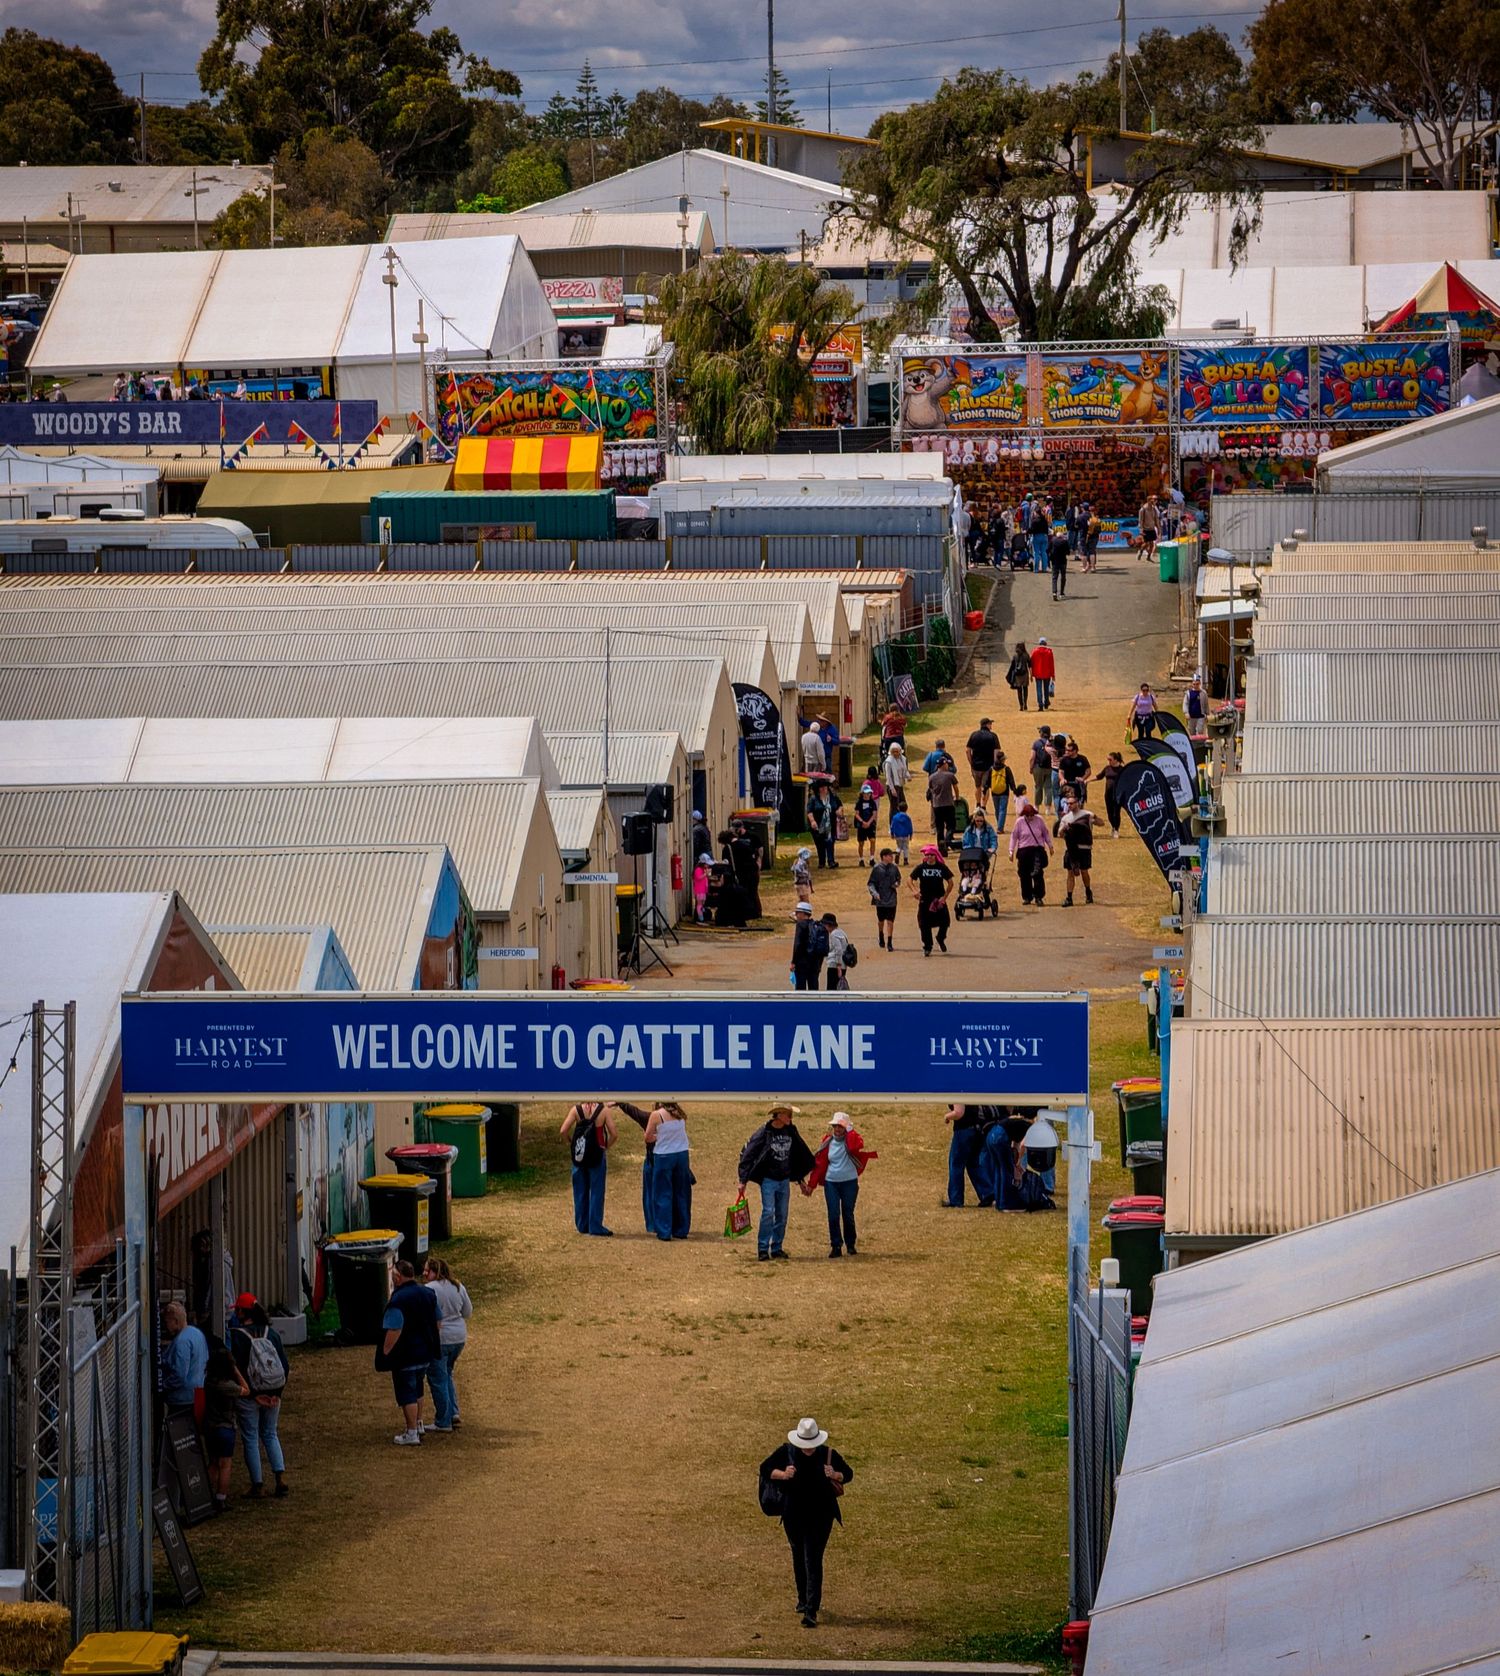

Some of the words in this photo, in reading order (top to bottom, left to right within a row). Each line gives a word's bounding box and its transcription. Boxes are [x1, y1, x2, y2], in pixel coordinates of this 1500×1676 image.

[1203, 361, 1278, 384] BUST-A
[1343, 357, 1418, 380] BUST-A
[1193, 382, 1298, 409] BALLOON
[1333, 379, 1438, 405] BALLOON
[959, 395, 1014, 411] AUSSIE
[1057, 392, 1112, 409] AUSSIE
[952, 409, 986, 421] THONG
[986, 409, 1021, 421] THROW
[1050, 406, 1084, 419] THONG
[1084, 406, 1119, 418] THROW
[32, 412, 131, 435] WOODY'S
[138, 412, 182, 434] BAR
[513, 420, 553, 434] ADVENTURE
[555, 421, 578, 431] STARTS
[1044, 439, 1070, 451] ONG
[1134, 794, 1164, 813] ANGUS
[1158, 838, 1181, 854] ANGUS
[490, 949, 526, 957] HEREFORD
[1164, 949, 1176, 957] RED
[174, 1037, 288, 1057] HARVEST
[333, 1024, 518, 1070] WELCOME
[528, 1024, 576, 1070] TO
[587, 1024, 751, 1070] CATTLE
[764, 1024, 876, 1070] LANE
[930, 1037, 1044, 1057] HARVEST
[211, 1059, 253, 1068] ROAD
[966, 1060, 1009, 1068] ROAD
